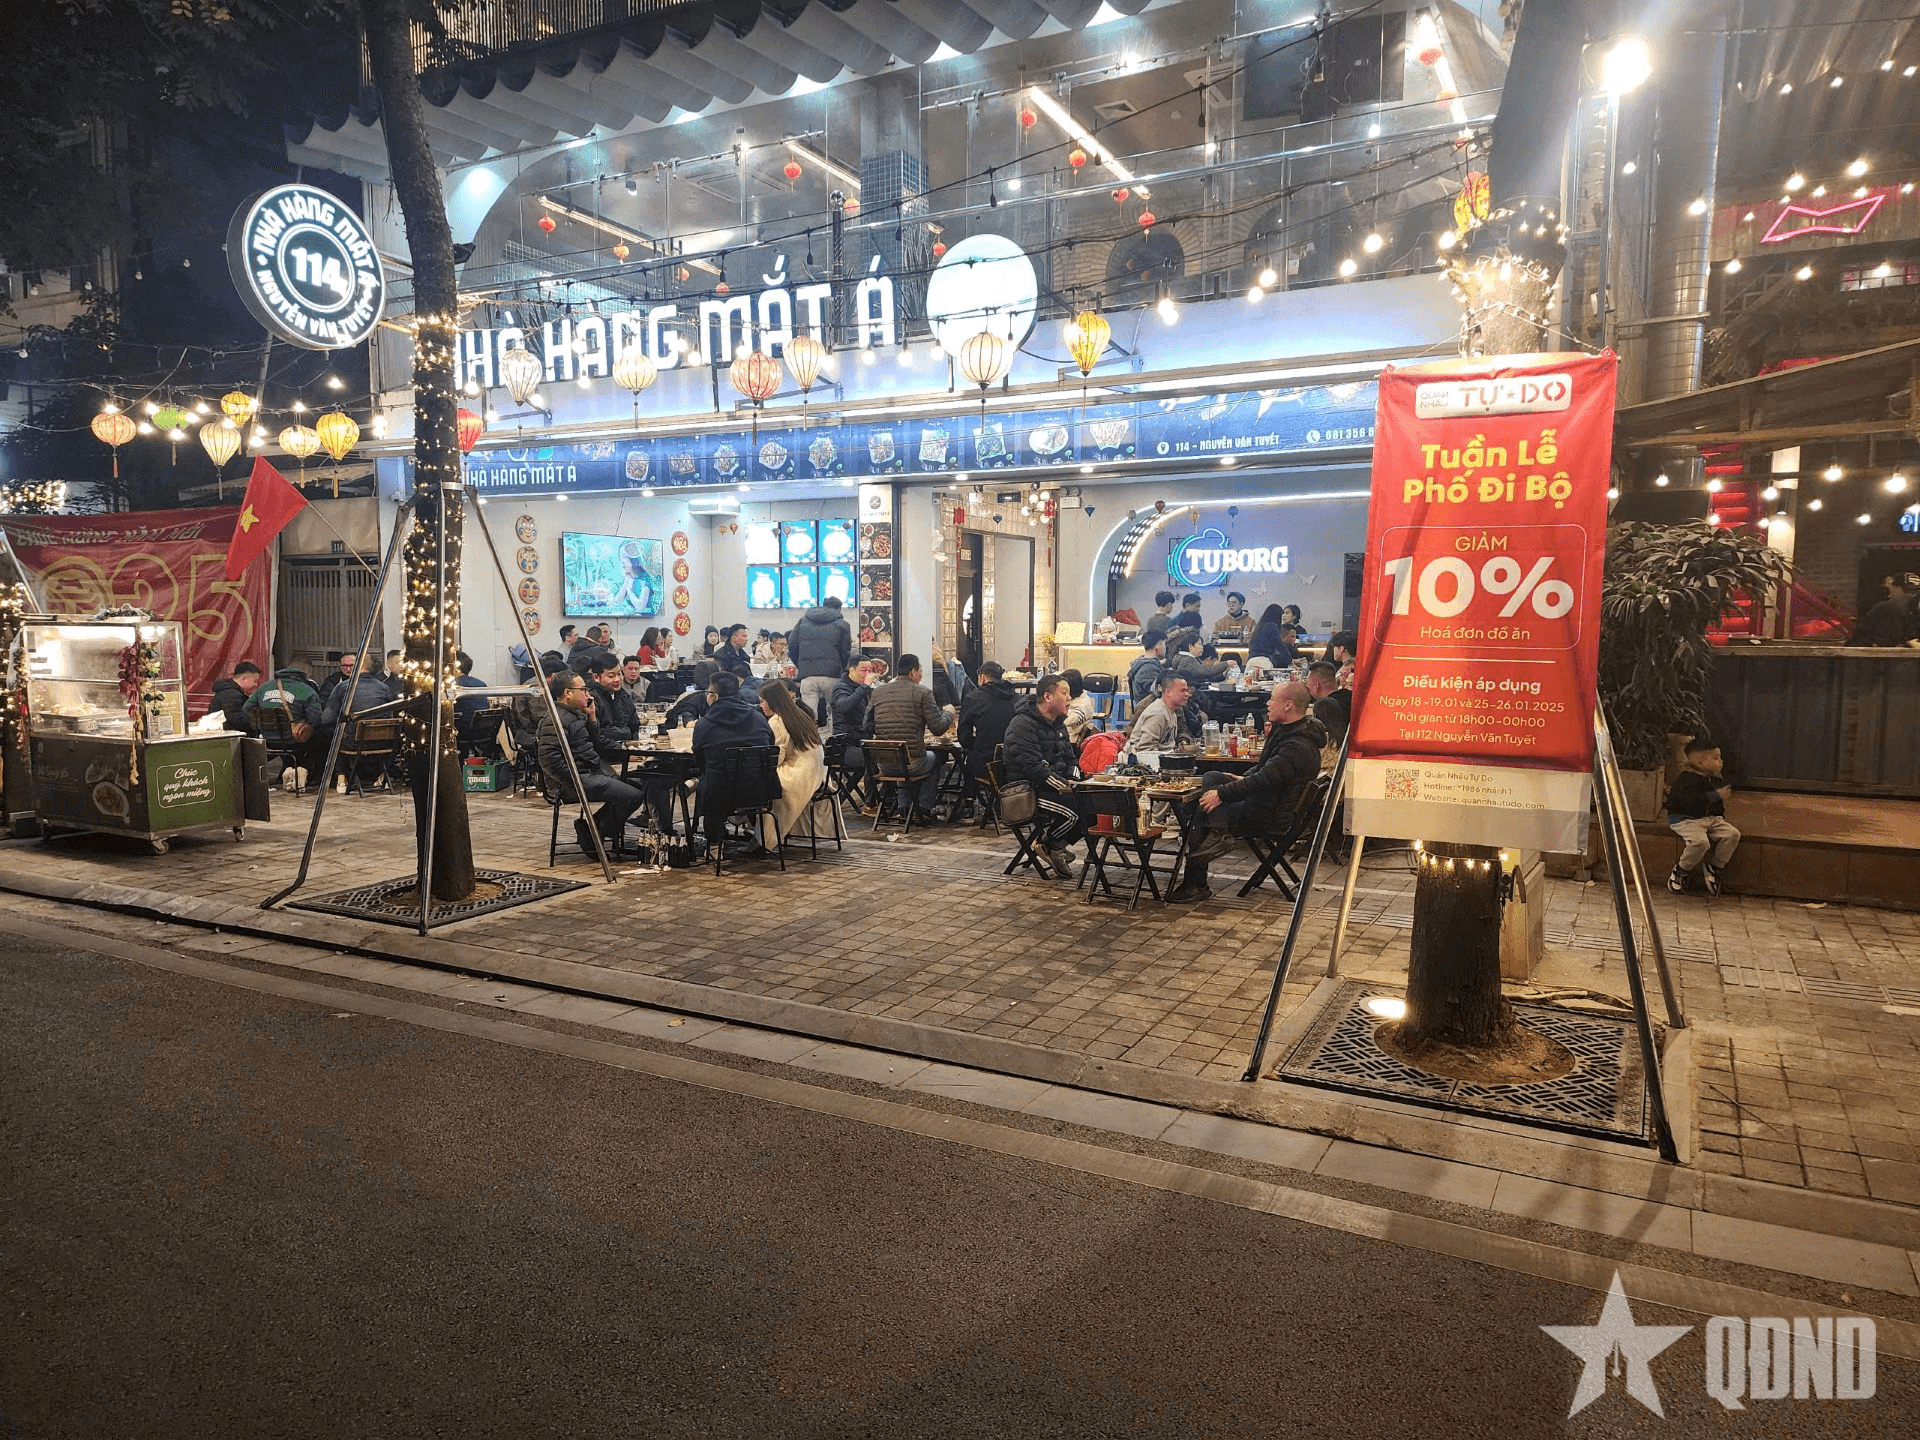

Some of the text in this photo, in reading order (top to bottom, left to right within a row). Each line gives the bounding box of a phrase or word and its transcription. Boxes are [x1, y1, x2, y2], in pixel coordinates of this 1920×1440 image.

[253, 206, 287, 256] NHÀ
[278, 191, 335, 226] HÀNG
[290, 247, 346, 290] 114
[257, 269, 307, 331] NGUYỄN
[543, 298, 677, 382] HÀNG
[699, 255, 832, 362] MẮT
[856, 255, 896, 347] Á
[1521, 380, 1567, 404] DO
[1175, 442, 1190, 452] 114
[1421, 428, 1558, 470] Tuần Lễ
[490, 464, 527, 487] HÀNG
[531, 458, 565, 485] MẮT
[567, 460, 577, 482] Á
[1403, 469, 1573, 509] Phố Đi Bộ
[1455, 531, 1508, 552] GIẢM
[1186, 546, 1289, 575] TUBORG
[1384, 555, 1575, 620] 10%
[1420, 625, 1531, 640] Hoá đơn đồ ăn
[1403, 675, 1541, 695] Điều kiện áp dụng
[1379, 695, 1408, 708] Ngày
[1410, 696, 1422, 706] 18
[1460, 699, 1472, 708] và
[1394, 711, 1417, 722] Thời
[1419, 713, 1443, 724] gian
[1399, 728, 1537, 747] Tại 112 Nguyễn Văn Tuyết
[174, 767, 199, 779] Chúc
[1481, 774, 1493, 782] Do
[163, 775, 209, 793] quý khách
[163, 787, 212, 803] ngon miệng
